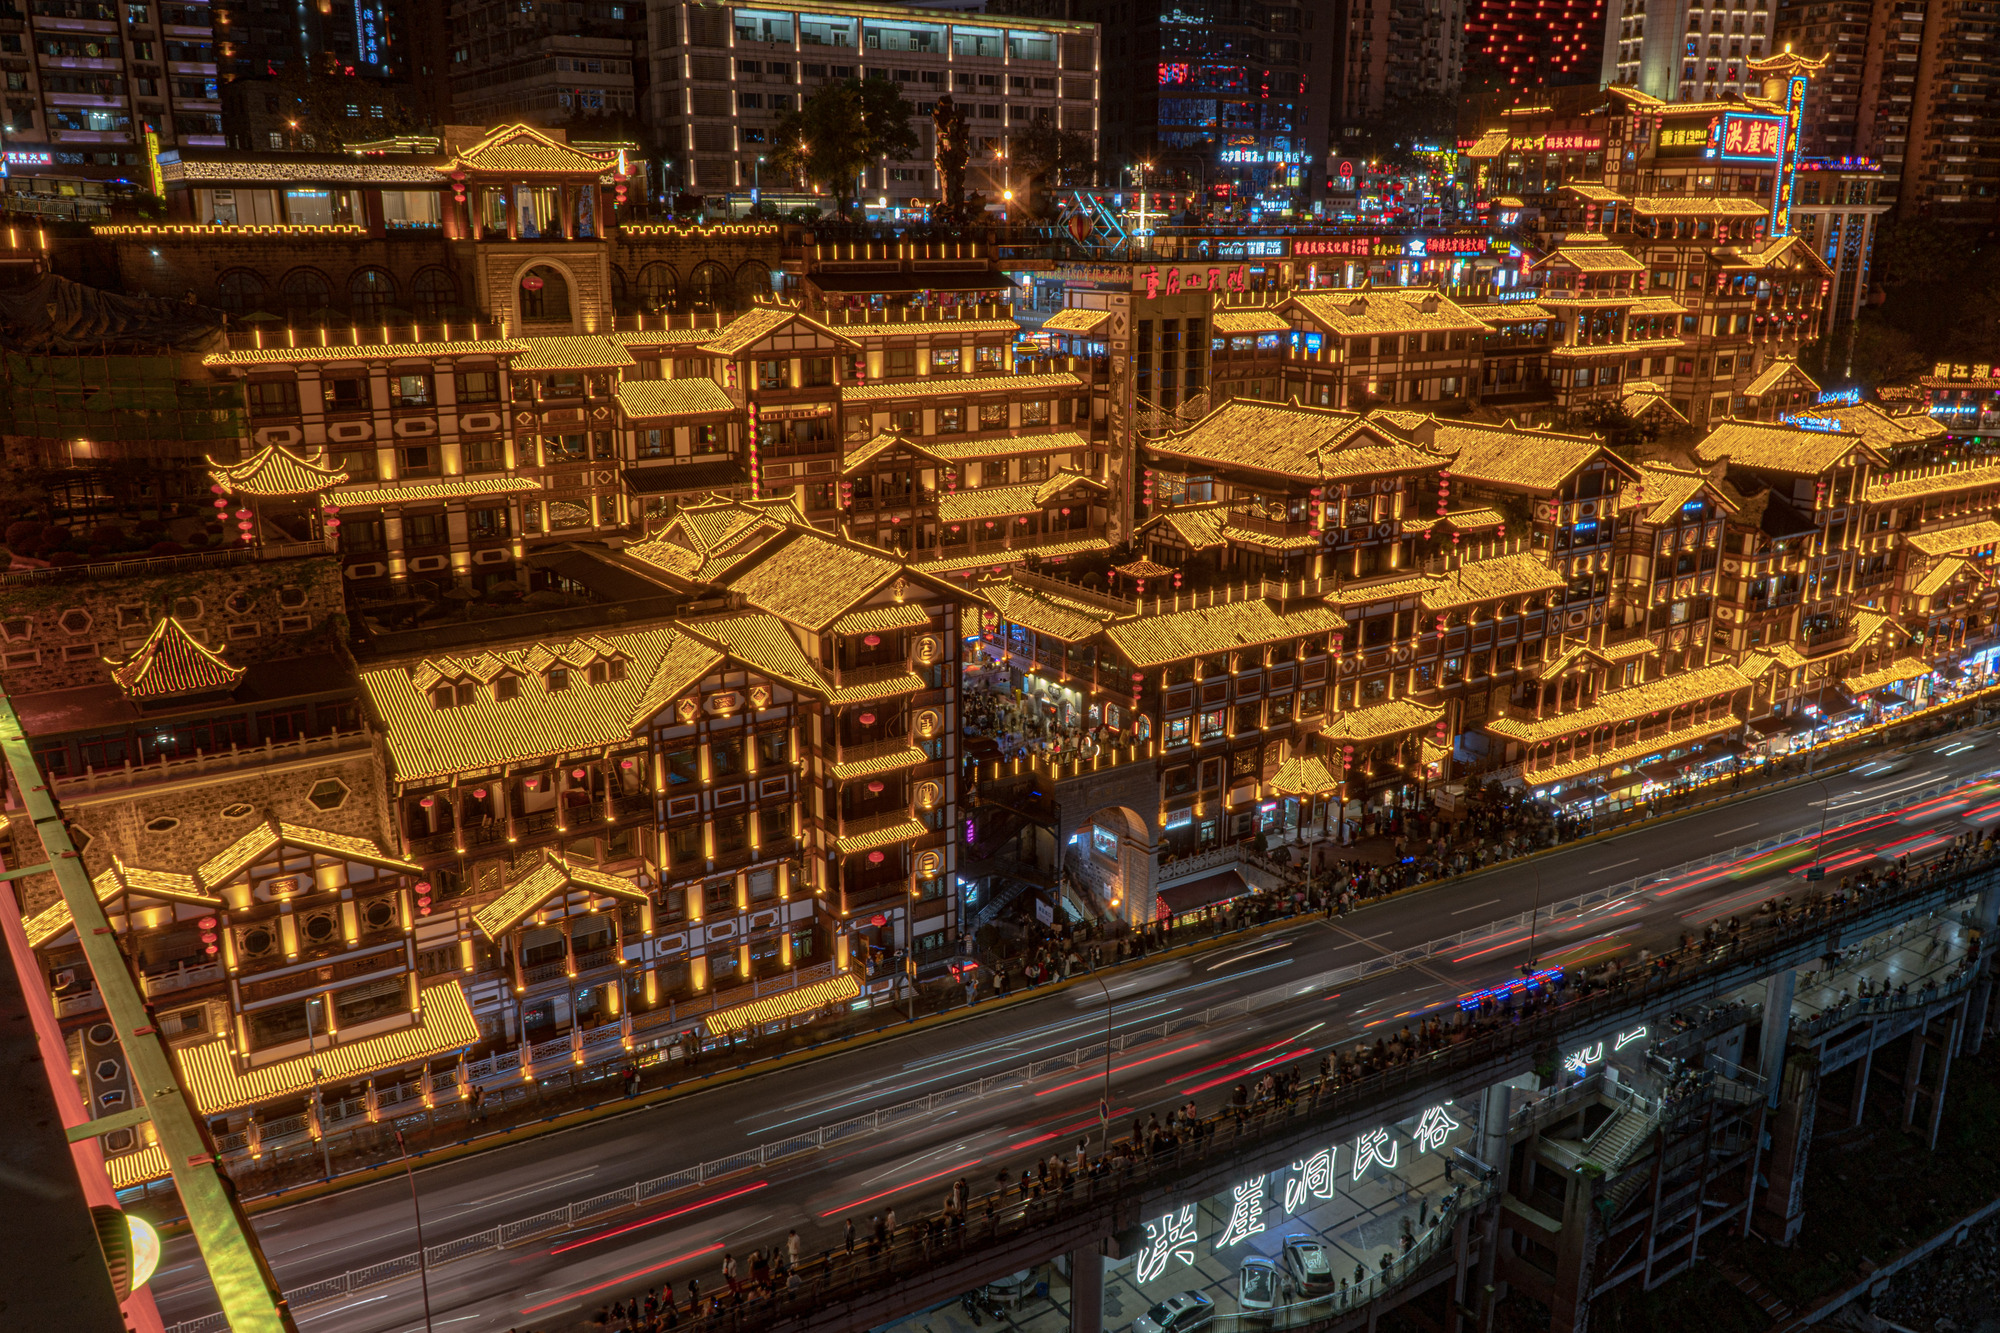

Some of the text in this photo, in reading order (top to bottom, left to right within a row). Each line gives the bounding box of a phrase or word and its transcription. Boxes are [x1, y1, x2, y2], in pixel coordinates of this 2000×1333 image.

[1725, 120, 1779, 153] 洪崖洞
[1140, 265, 1245, 299] 重庆小天鹅
[1934, 362, 1990, 378] 闹江湖
